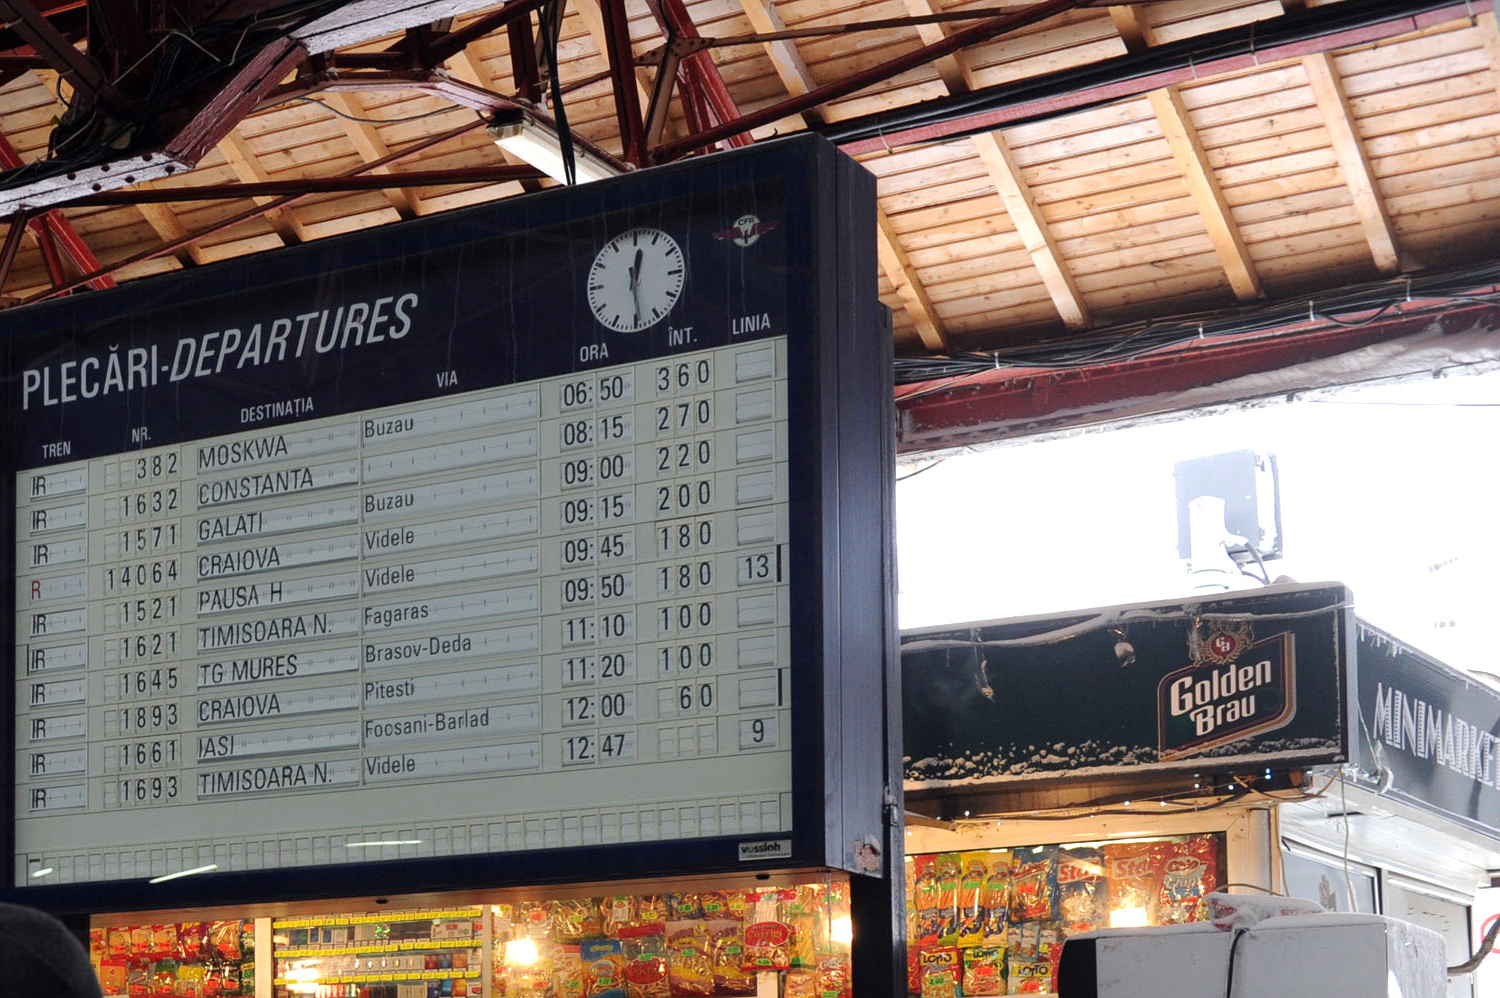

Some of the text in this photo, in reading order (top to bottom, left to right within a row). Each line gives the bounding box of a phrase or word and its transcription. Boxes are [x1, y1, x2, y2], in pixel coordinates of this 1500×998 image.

[23, 292, 418, 410] PLECĂRI-DEPARTURES
[43, 441, 71, 459] TREN
[132, 427, 151, 443] NR.
[437, 371, 458, 388] VIA
[580, 343, 609, 362] ORA
[668, 326, 698, 347] ÎNT.
[733, 313, 771, 335] LINIA
[137, 453, 178, 479] 382
[199, 435, 288, 468] MOSKWA
[364, 415, 414, 438] Buzau
[123, 489, 177, 516] 1632
[200, 468, 314, 504] CONSTANTA
[123, 525, 176, 551] 1571
[200, 512, 262, 541] GALATI
[364, 490, 414, 513] Buzau
[108, 560, 178, 589] 14064
[200, 546, 280, 577] CRAIOVA
[364, 527, 414, 550] Videle
[123, 597, 176, 624] 1521
[200, 586, 258, 611] PAUSA
[270, 581, 282, 602] H
[365, 566, 415, 589] Videle
[123, 632, 176, 658] 1621
[200, 616, 306, 647] TIMISOARA
[313, 613, 332, 634] N.
[364, 602, 428, 628] Fagaras
[745, 555, 769, 580] 13
[123, 668, 178, 692] 1645
[200, 664, 223, 685] TG
[232, 654, 298, 681] MURES
[365, 634, 472, 663] Brasov-Deda
[1171, 660, 1271, 716] Golden
[123, 704, 178, 729] 1893
[200, 694, 280, 722] CRAIOVA
[365, 679, 414, 700] Pitesti
[1190, 695, 1255, 736] Brau
[123, 741, 176, 765] 1661
[199, 735, 235, 757] IASI
[364, 707, 489, 738] Focsani-Barlad
[123, 777, 178, 800] 1693
[200, 765, 306, 794] TIMISOARA
[313, 762, 332, 783] N.
[366, 753, 415, 776] Videle
[752, 719, 764, 743] 9
